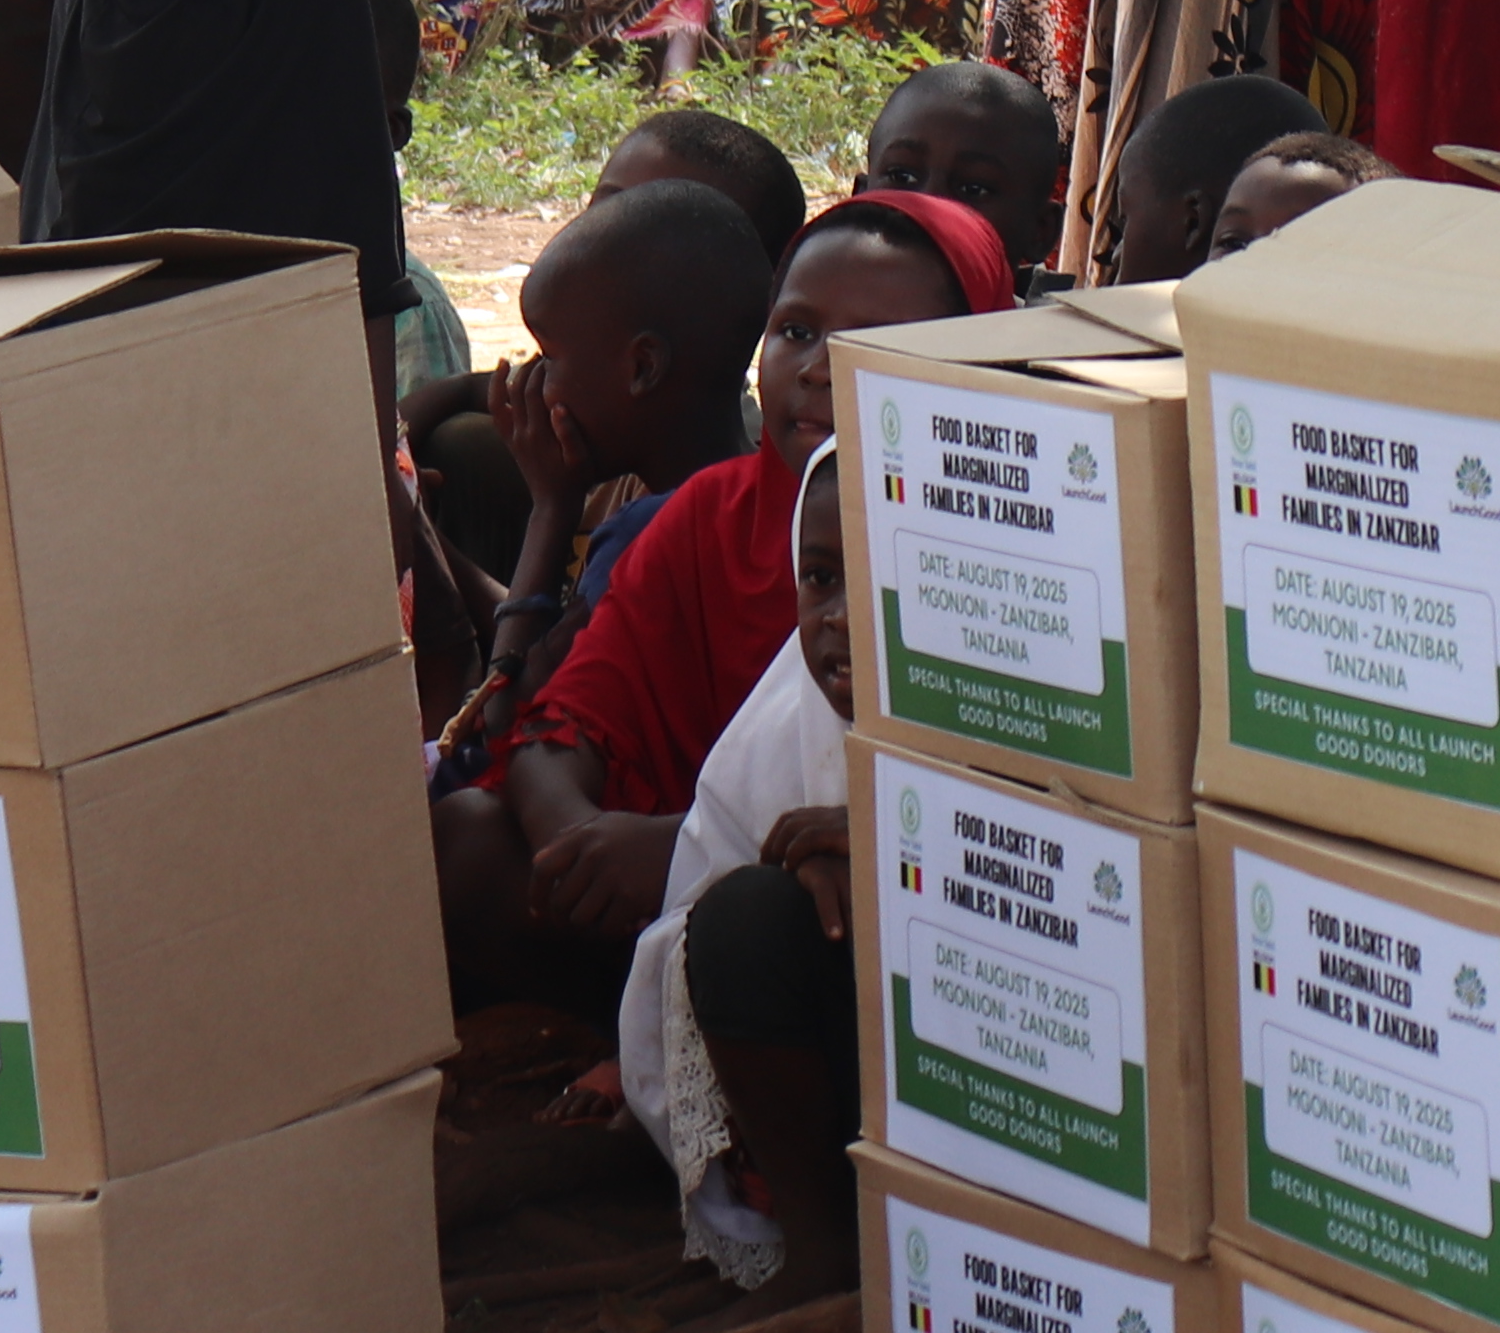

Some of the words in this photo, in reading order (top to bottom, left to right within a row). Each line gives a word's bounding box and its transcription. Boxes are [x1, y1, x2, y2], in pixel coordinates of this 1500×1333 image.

[932, 414, 962, 445] FOOD
[965, 421, 1010, 454] BASKET
[1014, 430, 1038, 459] FOR
[1293, 423, 1328, 456] FOOD
[1332, 430, 1386, 466] BASKET
[1391, 441, 1420, 472] FOR
[943, 452, 1029, 494] MARGINALIZED
[1305, 463, 1409, 509] MARGINALIZED
[924, 482, 975, 518] FAMILIES
[978, 494, 990, 521] IN
[993, 497, 1055, 534] ZANZIBAR
[1281, 495, 1343, 534] FAMILIES
[1346, 508, 1361, 537] IN
[1365, 512, 1440, 552] ZANZIBAR
[1274, 566, 1317, 599] DATE:
[1321, 578, 1386, 613] AUGUST
[1390, 593, 1409, 625] 19,
[1413, 597, 1455, 629] 2025
[1272, 602, 1358, 644] MGONJONI
[1373, 625, 1462, 672] ZANZIBAR,
[1324, 649, 1408, 692] TANZANIA
[1255, 689, 1311, 721] SPECIAL
[1314, 704, 1371, 736] THANKS
[1374, 719, 1395, 743] TO
[1399, 726, 1426, 751] ALL
[1430, 734, 1493, 767] LAUNCH
[1317, 731, 1361, 760] GOOD
[1365, 743, 1427, 778] DONORS
